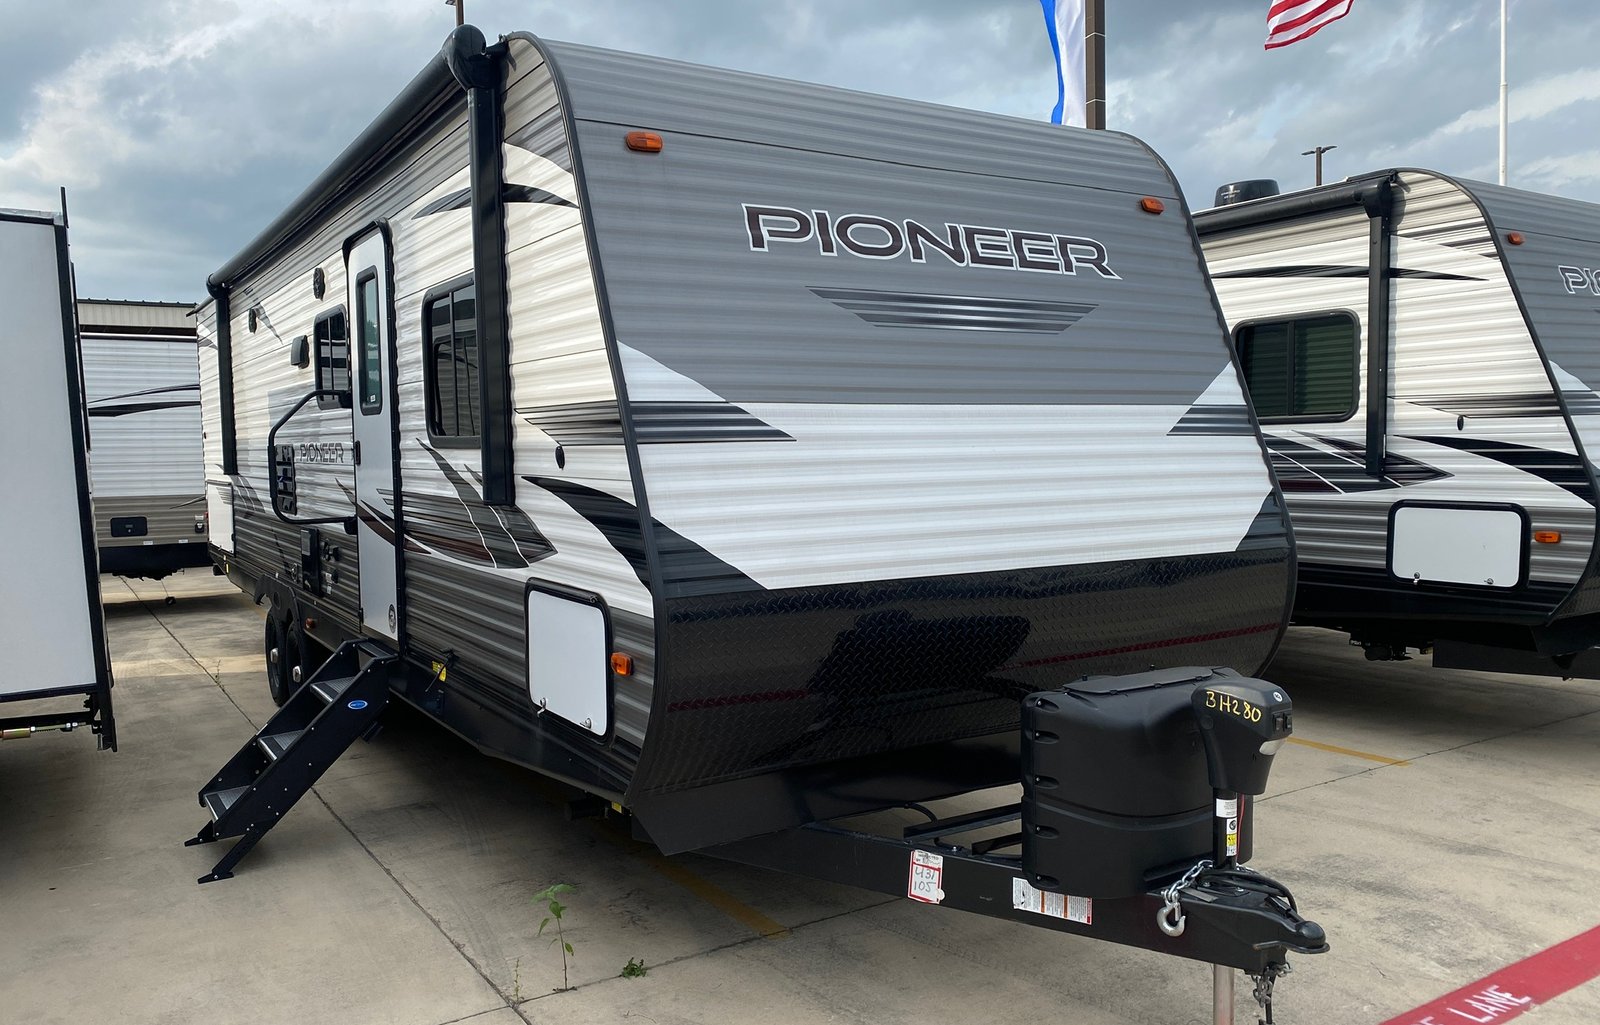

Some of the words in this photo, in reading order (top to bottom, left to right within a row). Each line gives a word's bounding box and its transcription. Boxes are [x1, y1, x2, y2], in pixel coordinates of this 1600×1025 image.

[741, 203, 1123, 280] PIONEER
[299, 442, 344, 463] PIONEER
[914, 881, 936, 893] 105
[1445, 984, 1532, 1023] LANE
